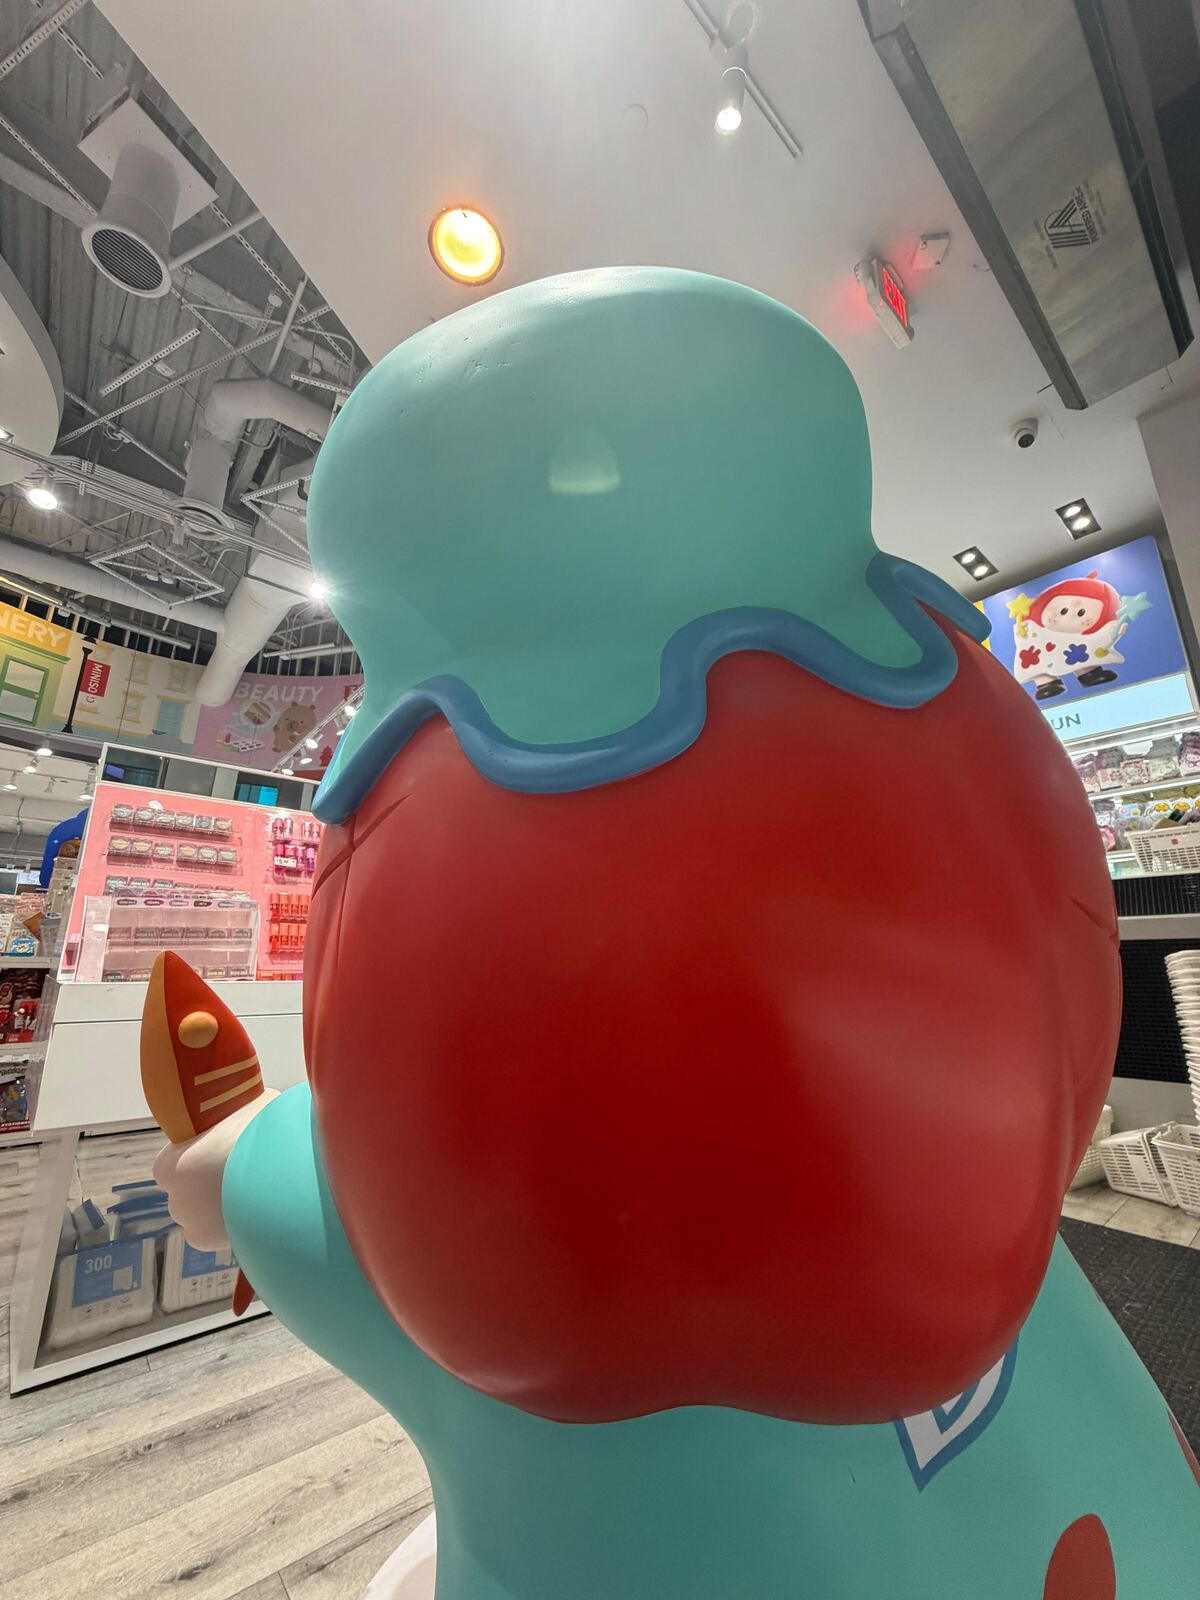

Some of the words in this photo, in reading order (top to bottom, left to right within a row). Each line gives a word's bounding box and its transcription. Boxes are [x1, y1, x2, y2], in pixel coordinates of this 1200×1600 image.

[882, 267, 908, 328] EXIT
[87, 663, 103, 694] MINISO
[234, 682, 324, 703] BEAUTY
[84, 1254, 113, 1274] 300
